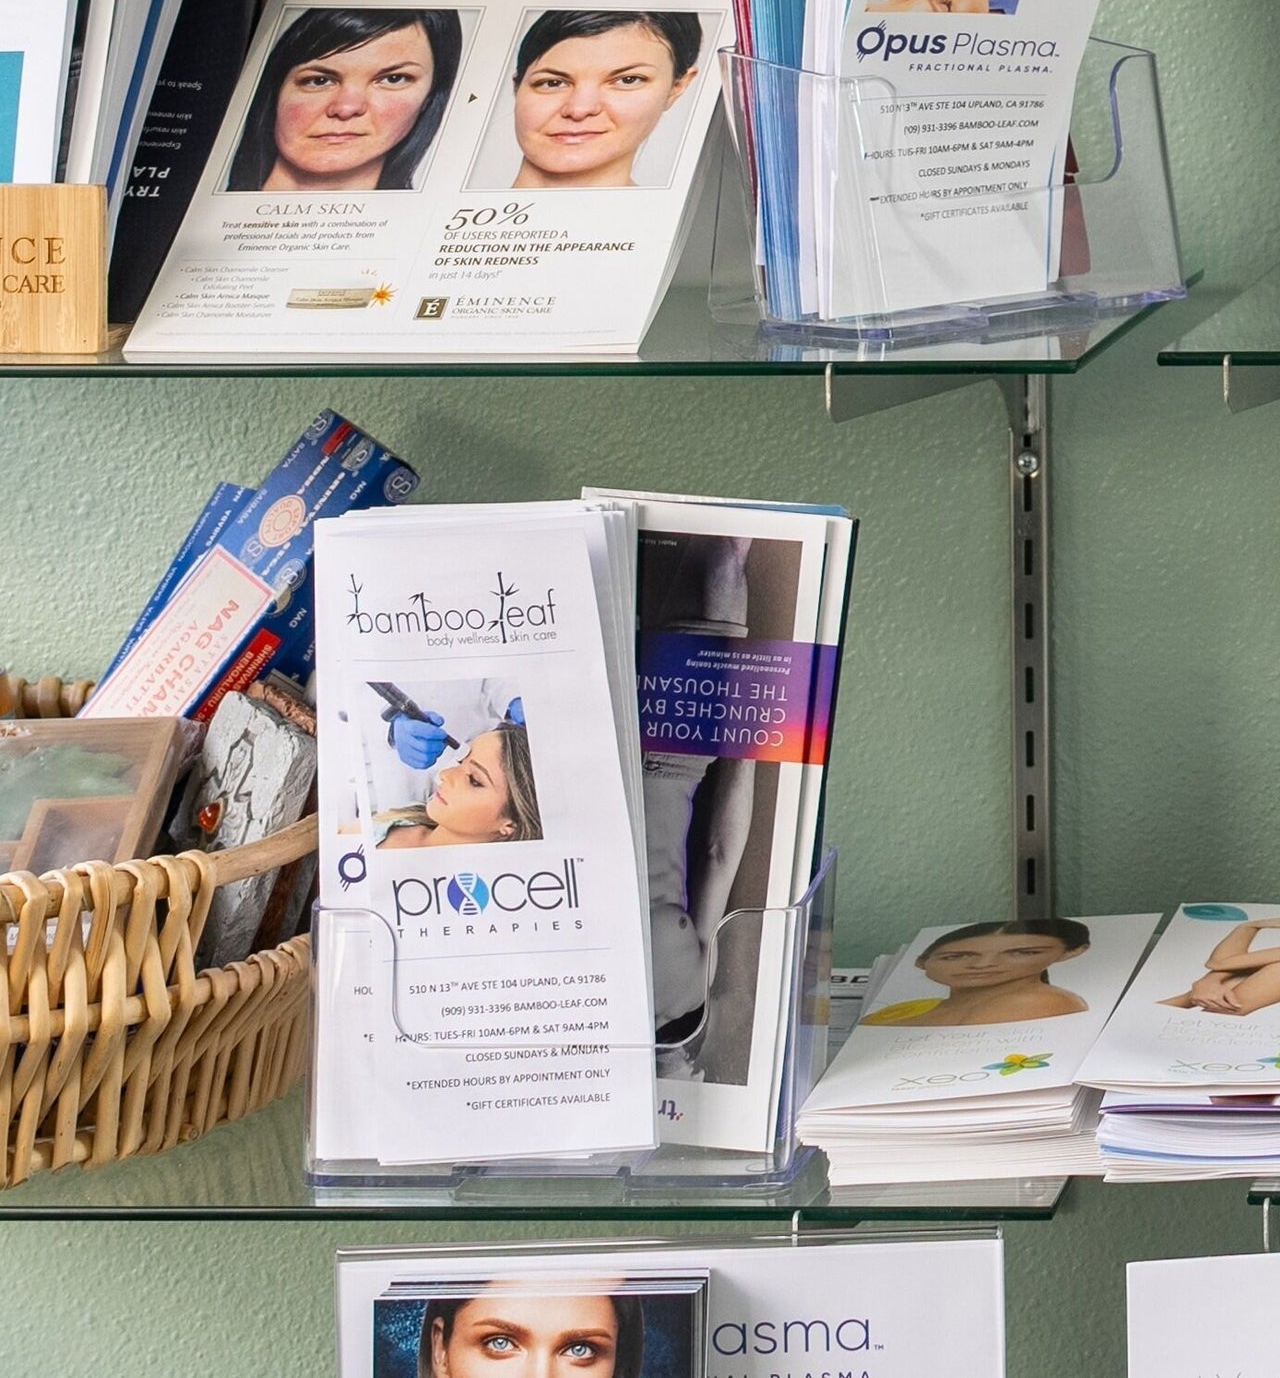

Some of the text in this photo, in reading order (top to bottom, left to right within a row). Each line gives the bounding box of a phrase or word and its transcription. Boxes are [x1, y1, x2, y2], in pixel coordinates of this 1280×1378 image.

[856, 20, 946, 62] Opus
[909, 62, 991, 73] FRACTIONAL
[256, 203, 366, 215] CALM SKIN
[445, 202, 531, 230] 50%
[439, 242, 635, 253] REDUCTION IN THE APPEARANCE
[434, 256, 539, 266] OF SKIN REDNESS
[2, 274, 66, 294] CARE
[347, 574, 485, 635] bamboo
[637, 675, 787, 701] THE THOUSAN
[642, 699, 786, 722] CRUNCHES BY
[646, 722, 784, 746] COUNT YOUR
[397, 919, 584, 939] THERAPIES
[409, 974, 606, 994] 510 N AVE STE 104 UPLAND, CA 91786
[441, 997, 608, 1017] (909) 931-3396 BAMBOO-LEAF.COM
